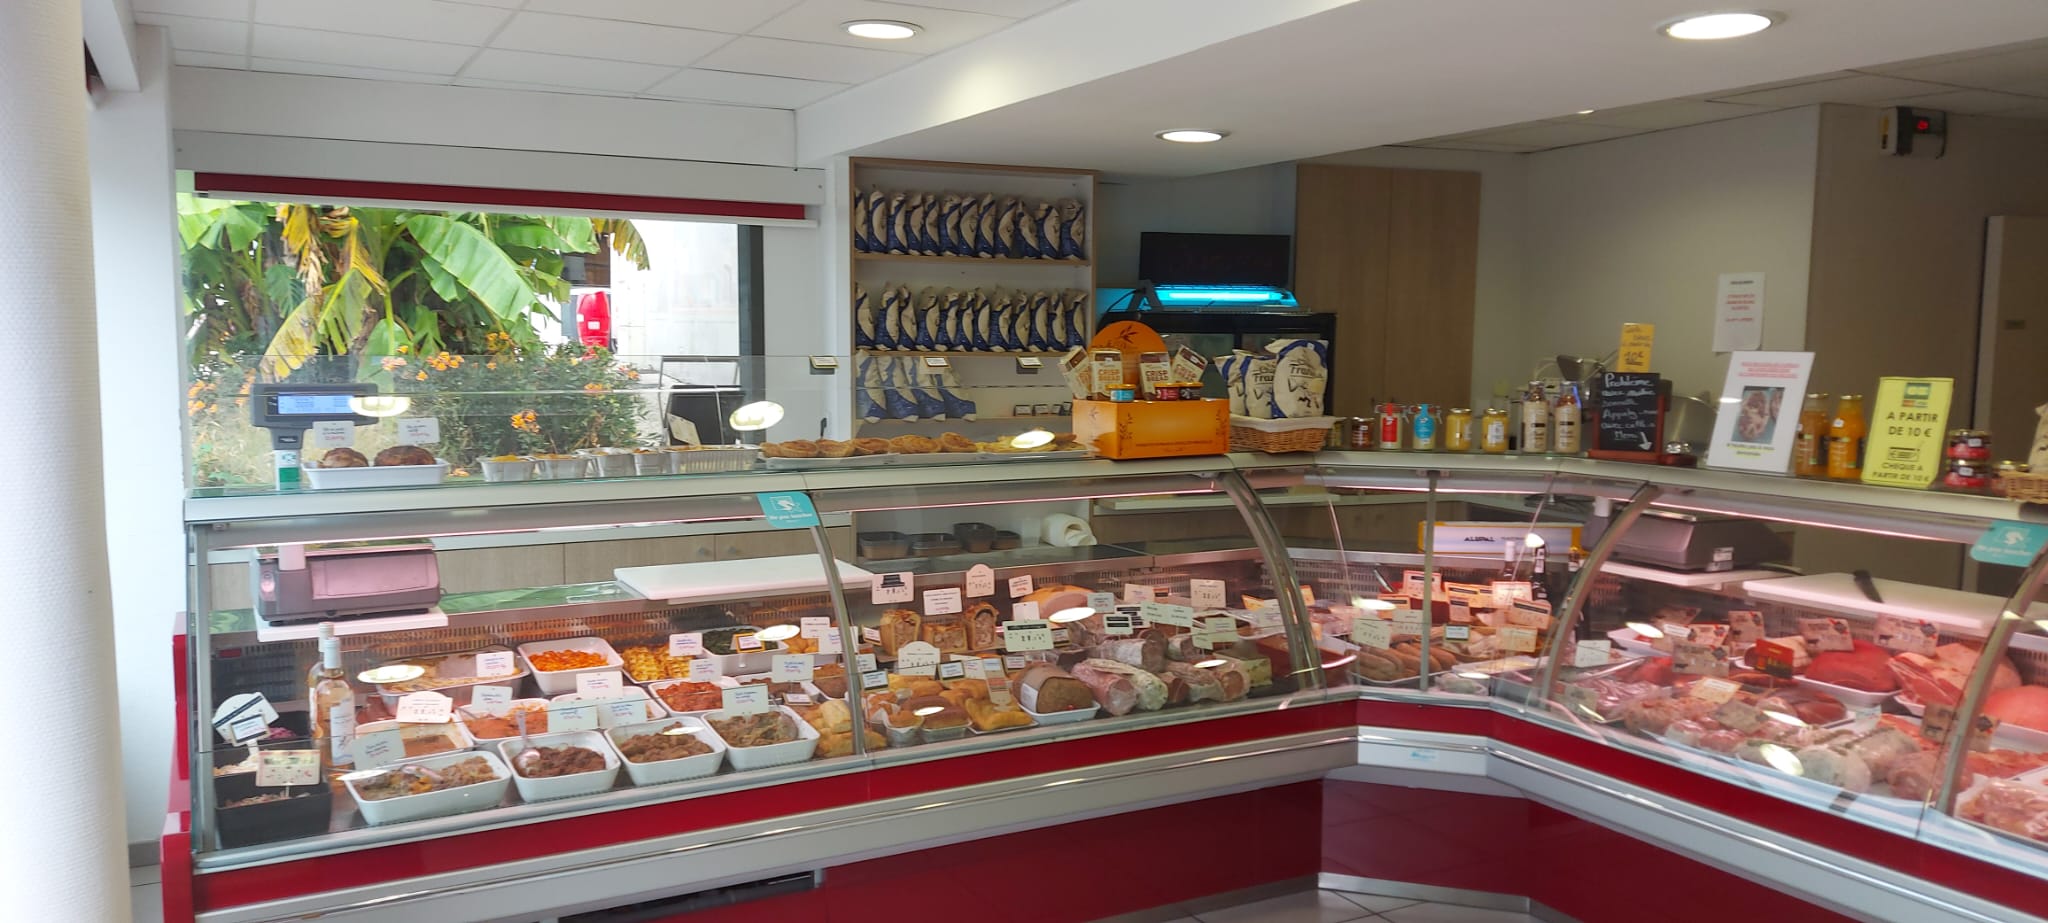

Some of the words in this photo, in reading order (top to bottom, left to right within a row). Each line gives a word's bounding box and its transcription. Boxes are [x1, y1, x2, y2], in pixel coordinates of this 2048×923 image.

[1899, 412, 1939, 423] PARTIR
[1888, 426, 1904, 436] DE
[1908, 427, 1921, 437] 10
[1924, 428, 1933, 438] €
